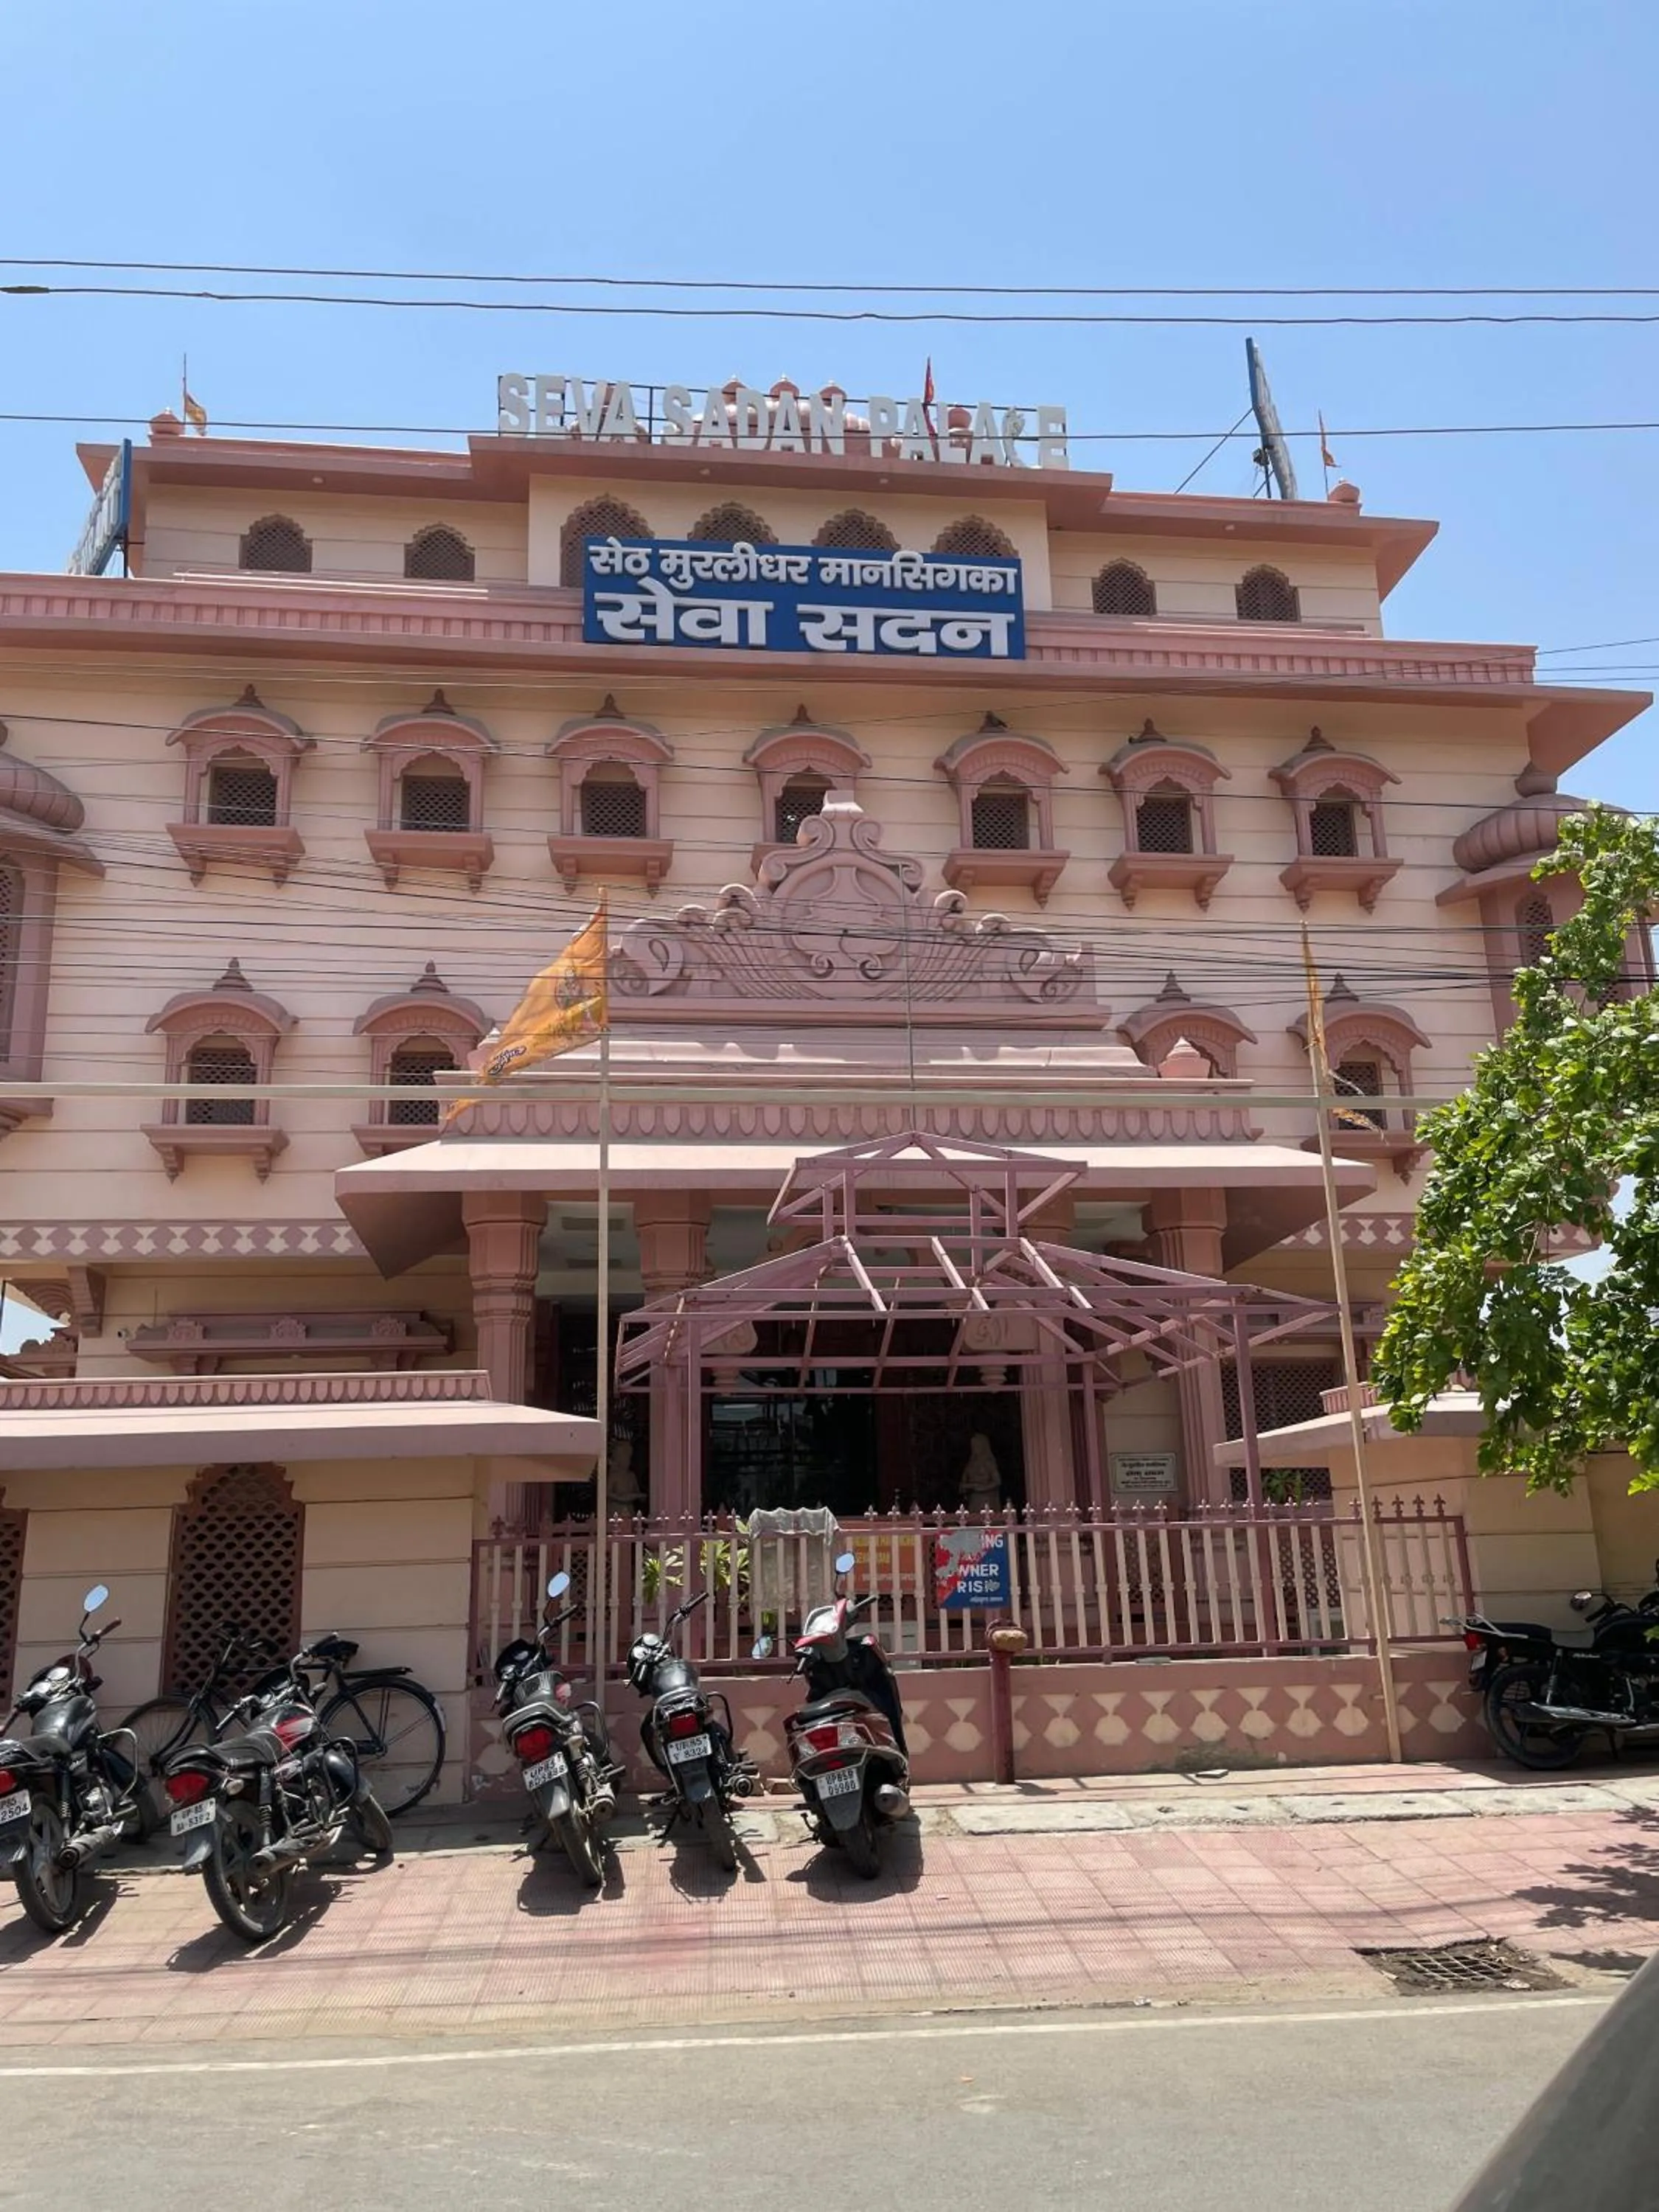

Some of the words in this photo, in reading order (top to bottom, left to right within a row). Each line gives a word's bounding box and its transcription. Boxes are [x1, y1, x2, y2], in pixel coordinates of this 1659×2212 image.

[500, 373, 641, 444] SEVA
[661, 385, 845, 456] SADAN
[869, 397, 1069, 470] PALACE
[588, 536, 652, 576] सेठ
[659, 541, 811, 590] मुरलीधर
[594, 576, 773, 646] सेवा
[796, 604, 1015, 656] सदन
[958, 1564, 999, 1577] WNER
